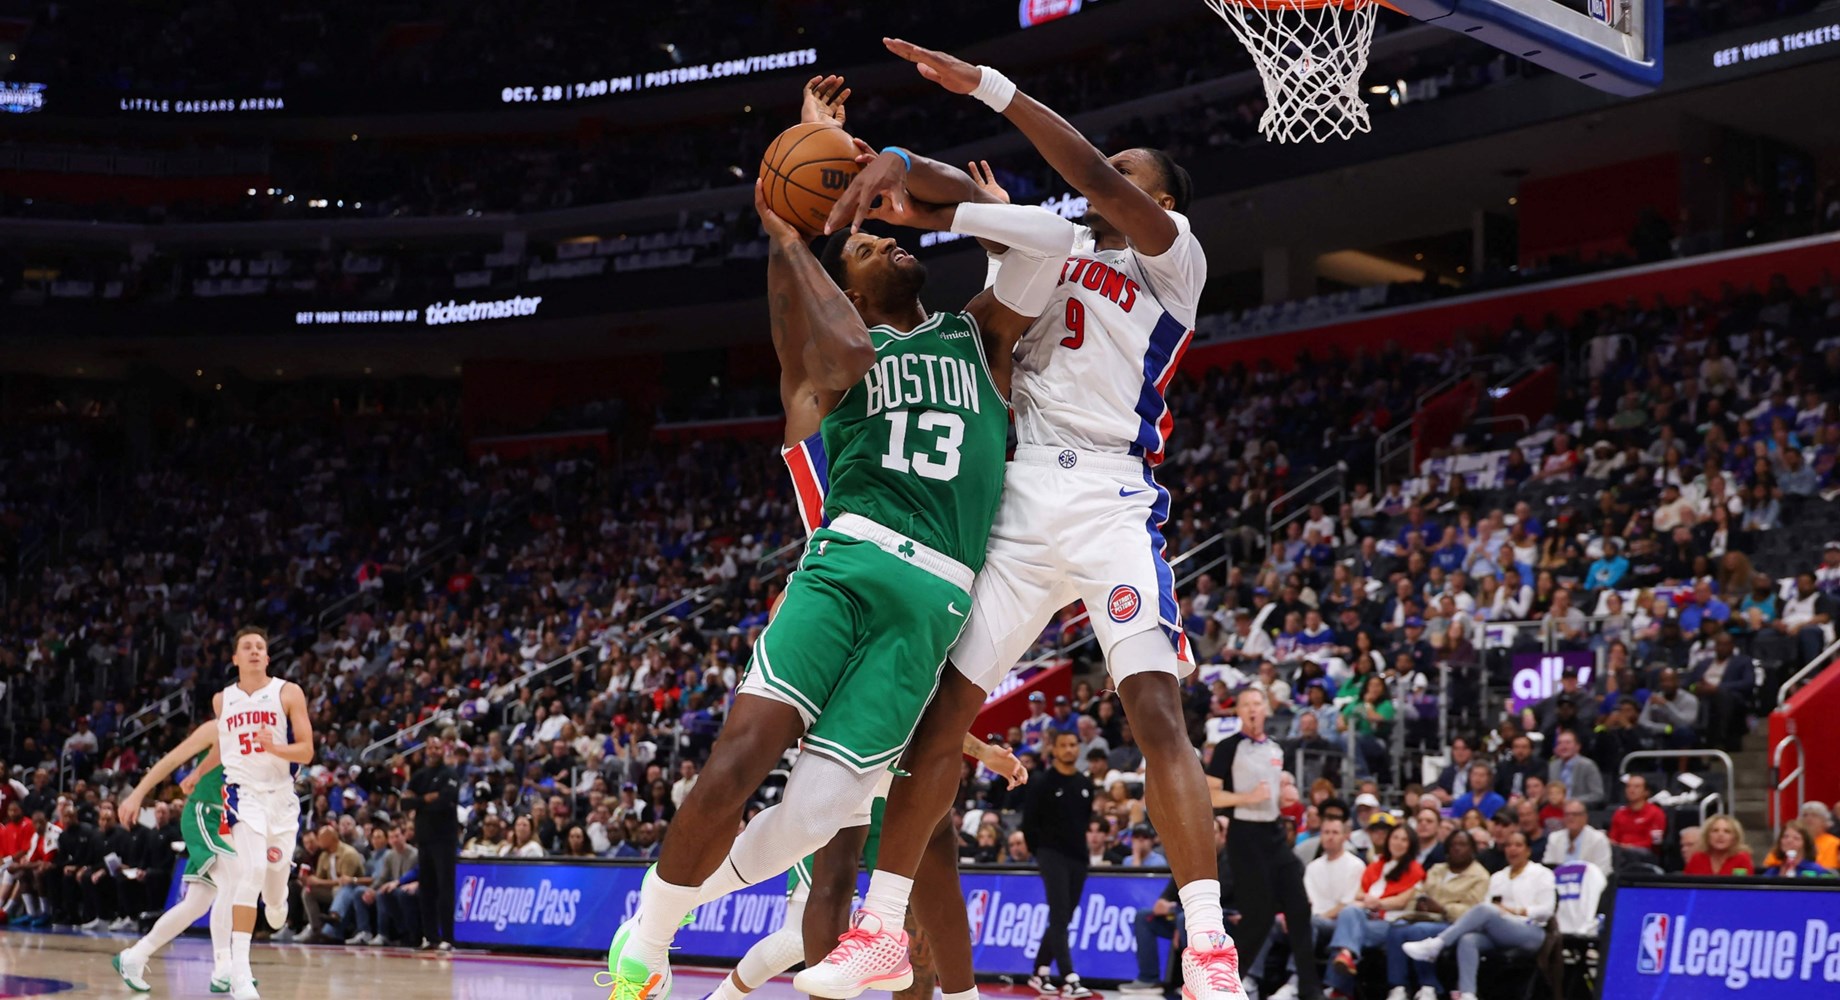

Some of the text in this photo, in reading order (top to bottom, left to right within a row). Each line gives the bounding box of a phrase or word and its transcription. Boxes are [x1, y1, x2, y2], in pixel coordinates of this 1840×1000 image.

[1713, 23, 1840, 68] GET YOUR TICKETS
[501, 48, 818, 103] OCT. 28 7:00 PM PISTONS.COM/TICKETS
[120, 97, 284, 113] LITTLE CAESARS ARENA
[315, 311, 340, 324] YOUR
[341, 310, 380, 323] TICKETS
[381, 309, 405, 322] NOW
[425, 295, 542, 325] ticketmaster
[939, 329, 971, 341] Amica
[1060, 296, 1085, 350] 9
[864, 353, 980, 418] BOSTON
[881, 410, 966, 482] 13
[226, 711, 277, 732] PISTONS
[469, 877, 536, 932] League
[531, 879, 581, 926] Pass
[983, 890, 1082, 960] Leage
[1669, 915, 1798, 990] League
